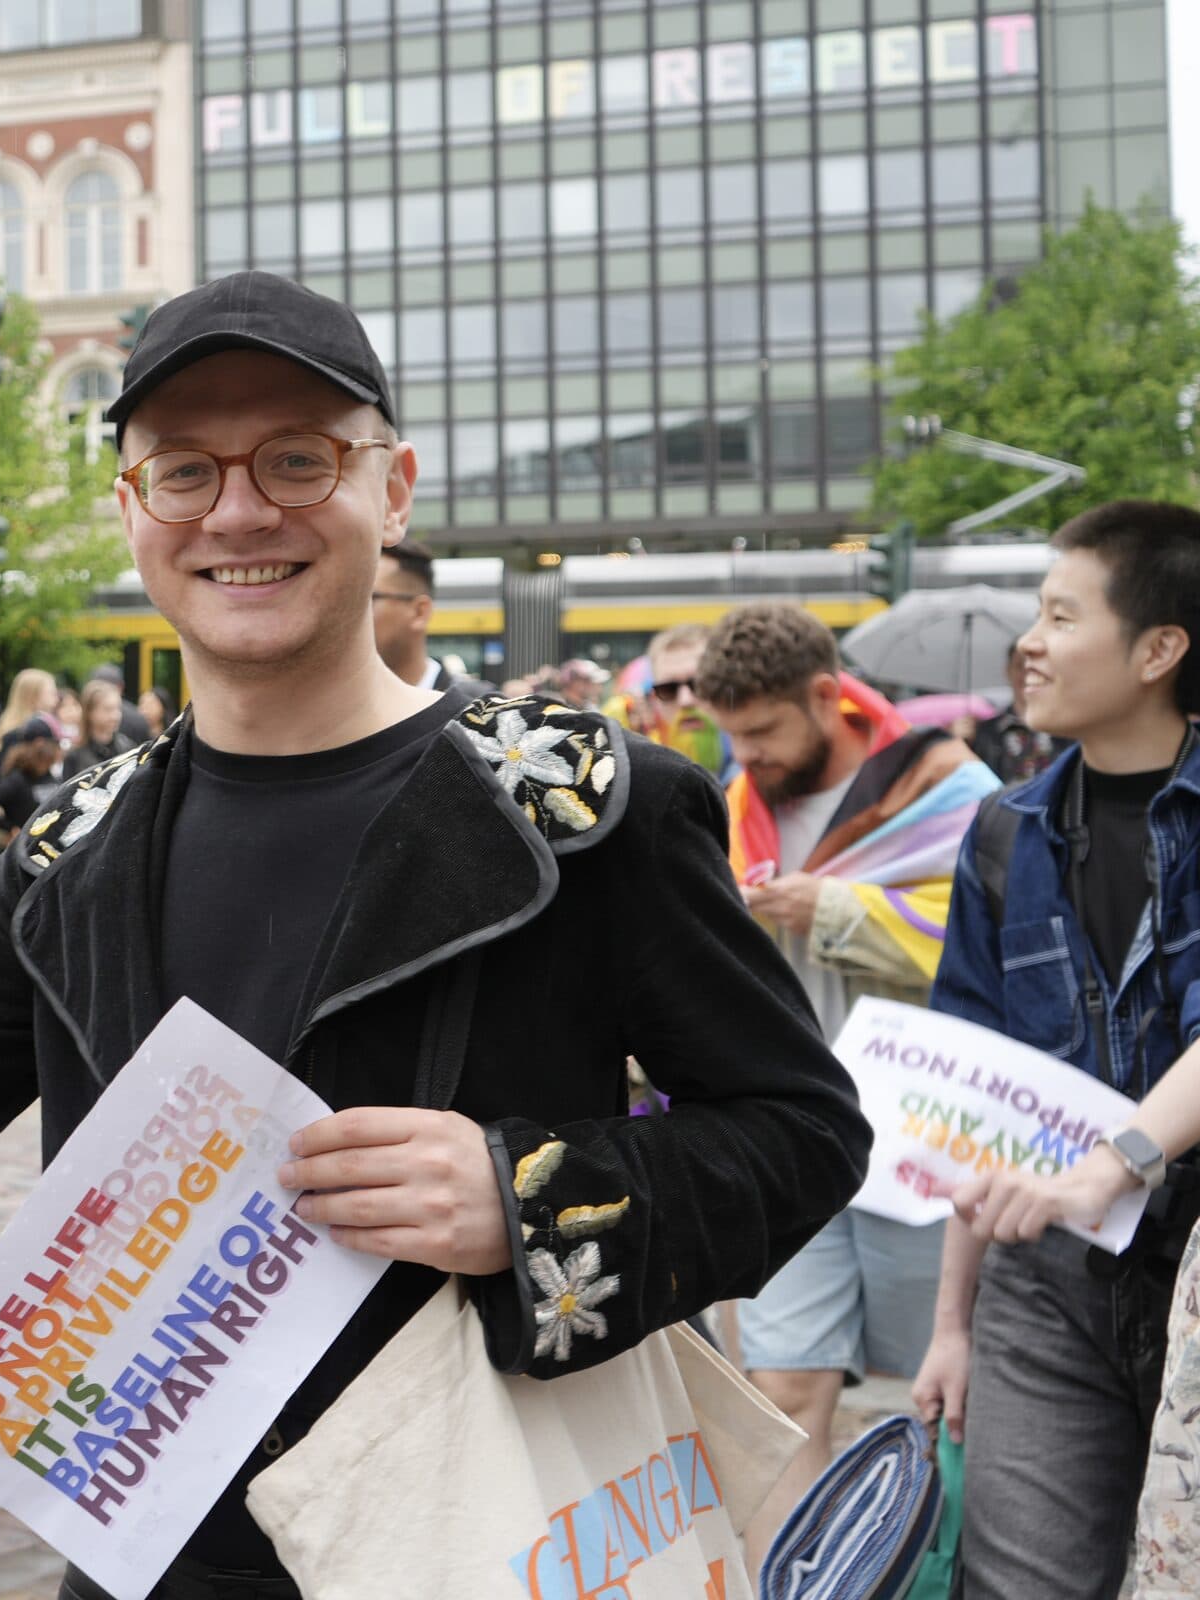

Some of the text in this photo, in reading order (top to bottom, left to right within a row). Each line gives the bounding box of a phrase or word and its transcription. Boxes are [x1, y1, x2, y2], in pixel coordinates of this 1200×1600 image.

[204, 15, 1035, 151] FULL OF RESPECT
[863, 1036, 1103, 1153] UPPORT NOW
[15, 1130, 245, 1414] PRIVILEDGE
[24, 1187, 118, 1295] LIFE
[45, 1190, 276, 1501] BASELINE OF
[74, 1203, 320, 1527] HUMAN RIGH
[14, 1373, 107, 1477] IT IS
